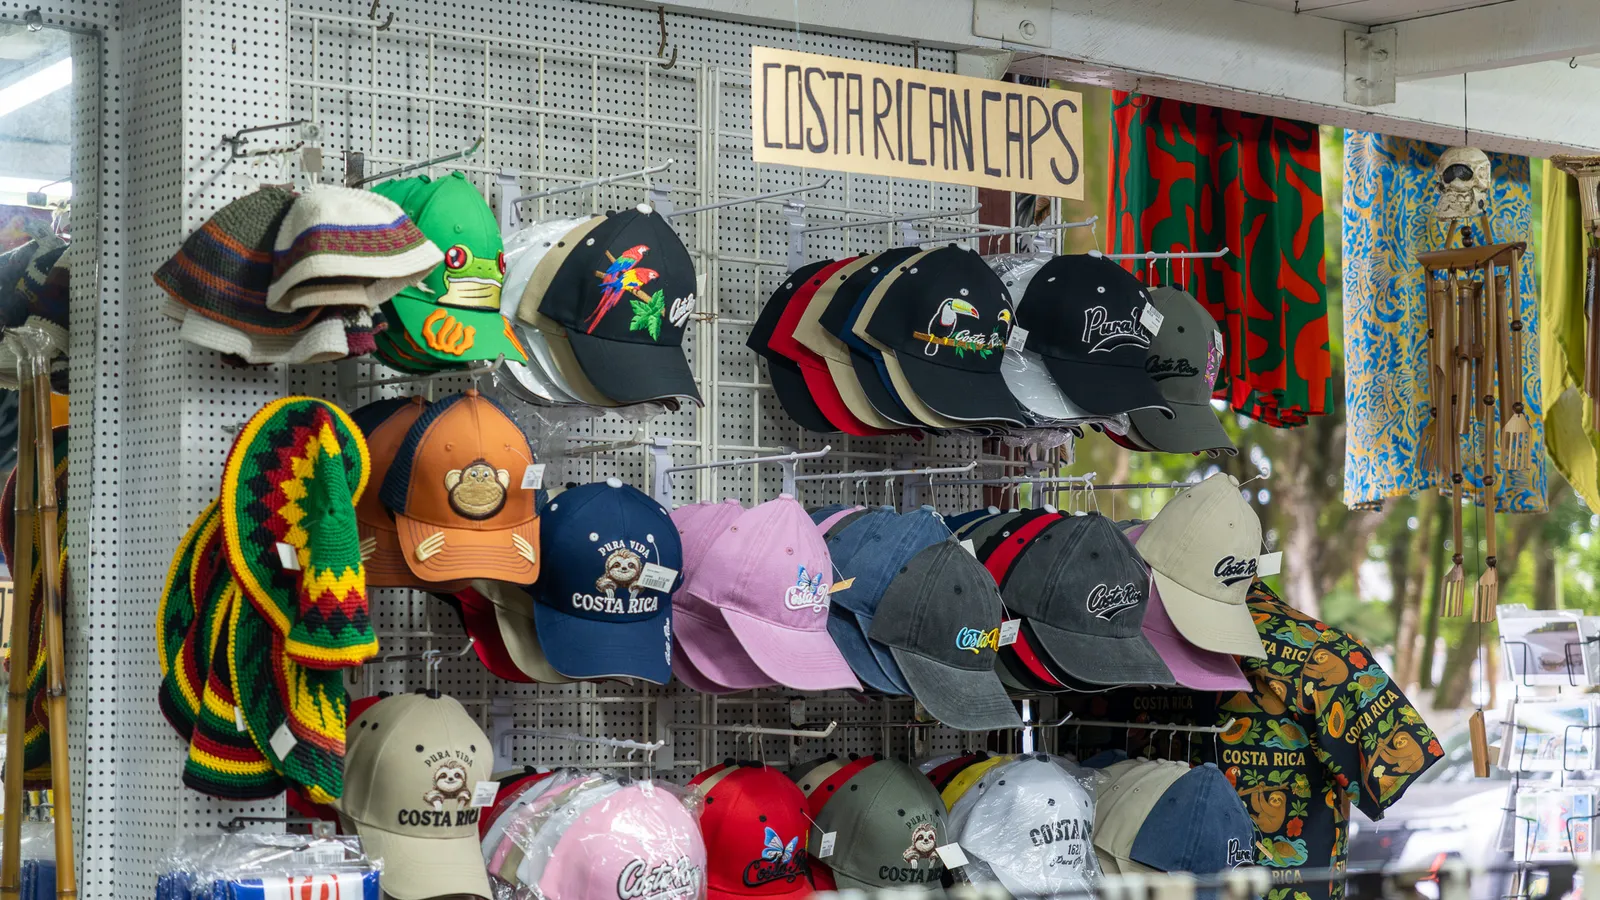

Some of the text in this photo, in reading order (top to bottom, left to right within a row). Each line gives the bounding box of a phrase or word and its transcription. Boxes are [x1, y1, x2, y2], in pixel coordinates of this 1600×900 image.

[762, 63, 1079, 186] COSTA RICAN CAPS
[1081, 305, 1133, 343] Pura
[954, 329, 986, 345] Costa
[597, 539, 651, 559] PURA VIDA
[1213, 554, 1247, 577] Costa
[571, 592, 659, 614] COSTA RICA
[1087, 583, 1124, 613] Costa
[956, 626, 989, 654] Costa
[1281, 645, 1308, 662] RIC
[1133, 695, 1194, 710] COSTA RICA
[1344, 711, 1375, 744] COSTA
[1370, 689, 1400, 719] RICA
[424, 750, 474, 768] PURA VIDA
[1222, 749, 1306, 766] COSTA RICA
[397, 808, 453, 827] COSTA
[905, 813, 927, 830] PURA
[1029, 818, 1081, 847] COSTA
[879, 865, 924, 883] COSTA
[1271, 868, 1304, 885] RICA
